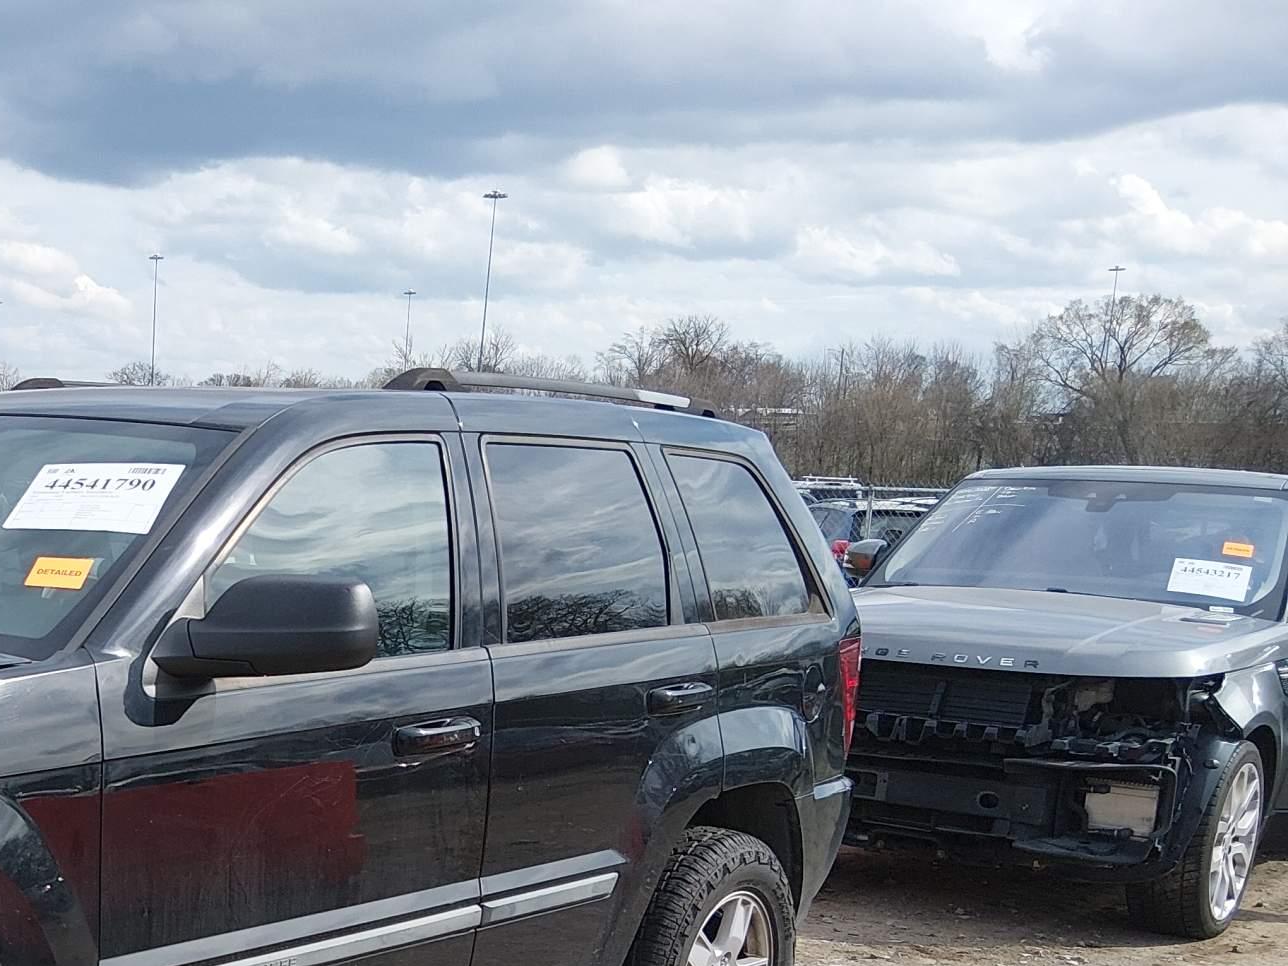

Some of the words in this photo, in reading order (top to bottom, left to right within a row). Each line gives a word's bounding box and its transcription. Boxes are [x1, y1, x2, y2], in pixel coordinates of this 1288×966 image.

[44, 478, 156, 491] 44541790
[36, 568, 82, 577] DETAILED
[1180, 566, 1241, 580] 44543217
[931, 653, 1039, 669] ROVER
